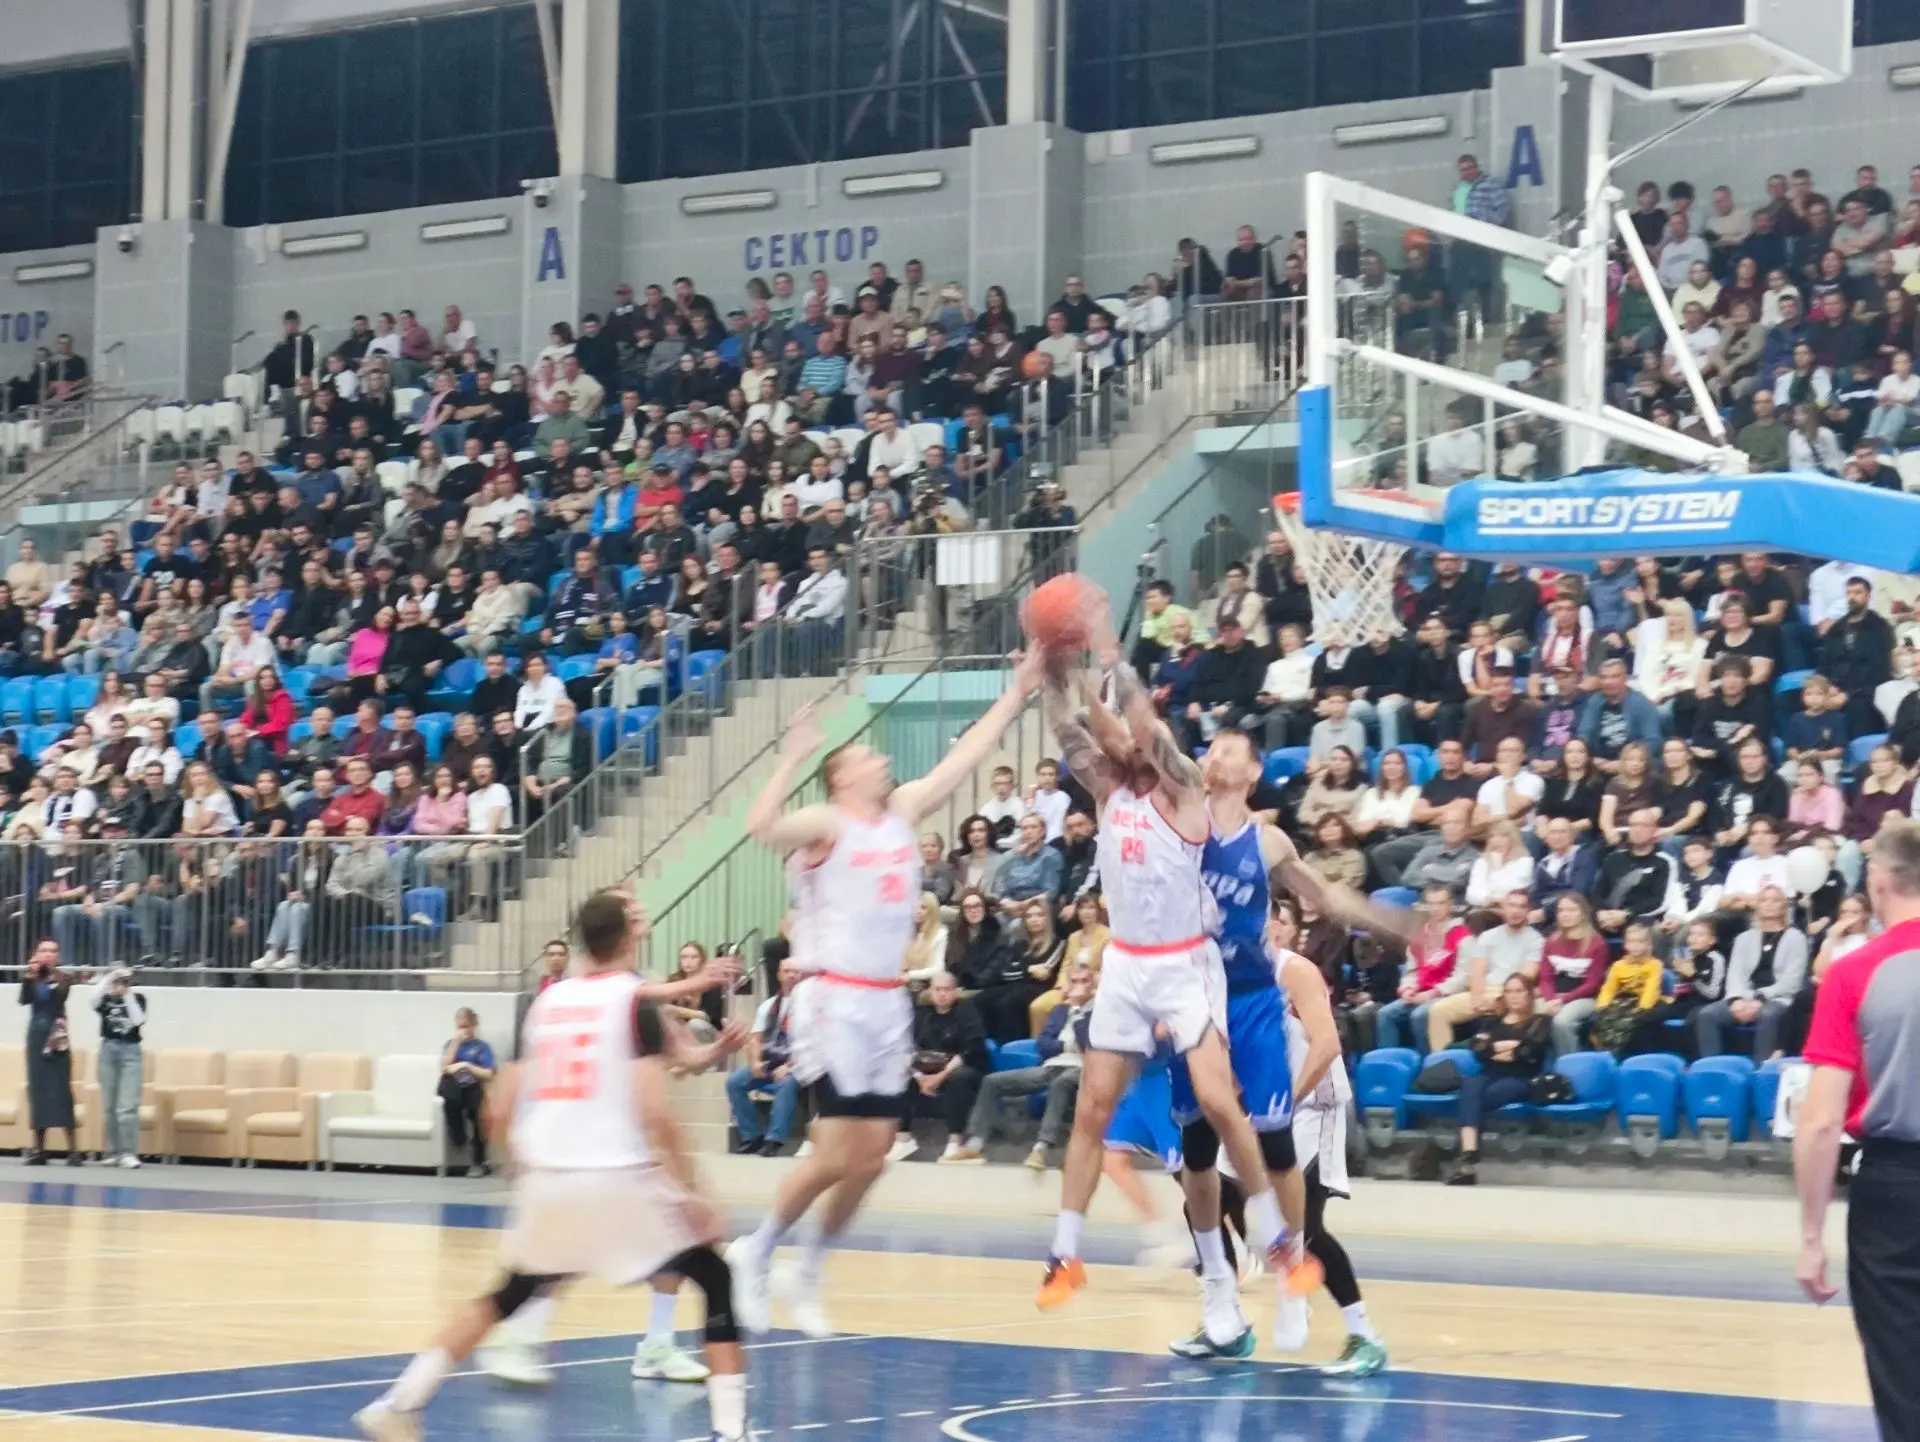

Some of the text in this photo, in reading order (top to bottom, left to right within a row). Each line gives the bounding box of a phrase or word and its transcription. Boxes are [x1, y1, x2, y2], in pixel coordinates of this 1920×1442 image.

[1506, 125, 1543, 188] А
[536, 226, 567, 282] А
[744, 225, 878, 272] СЕКТОР
